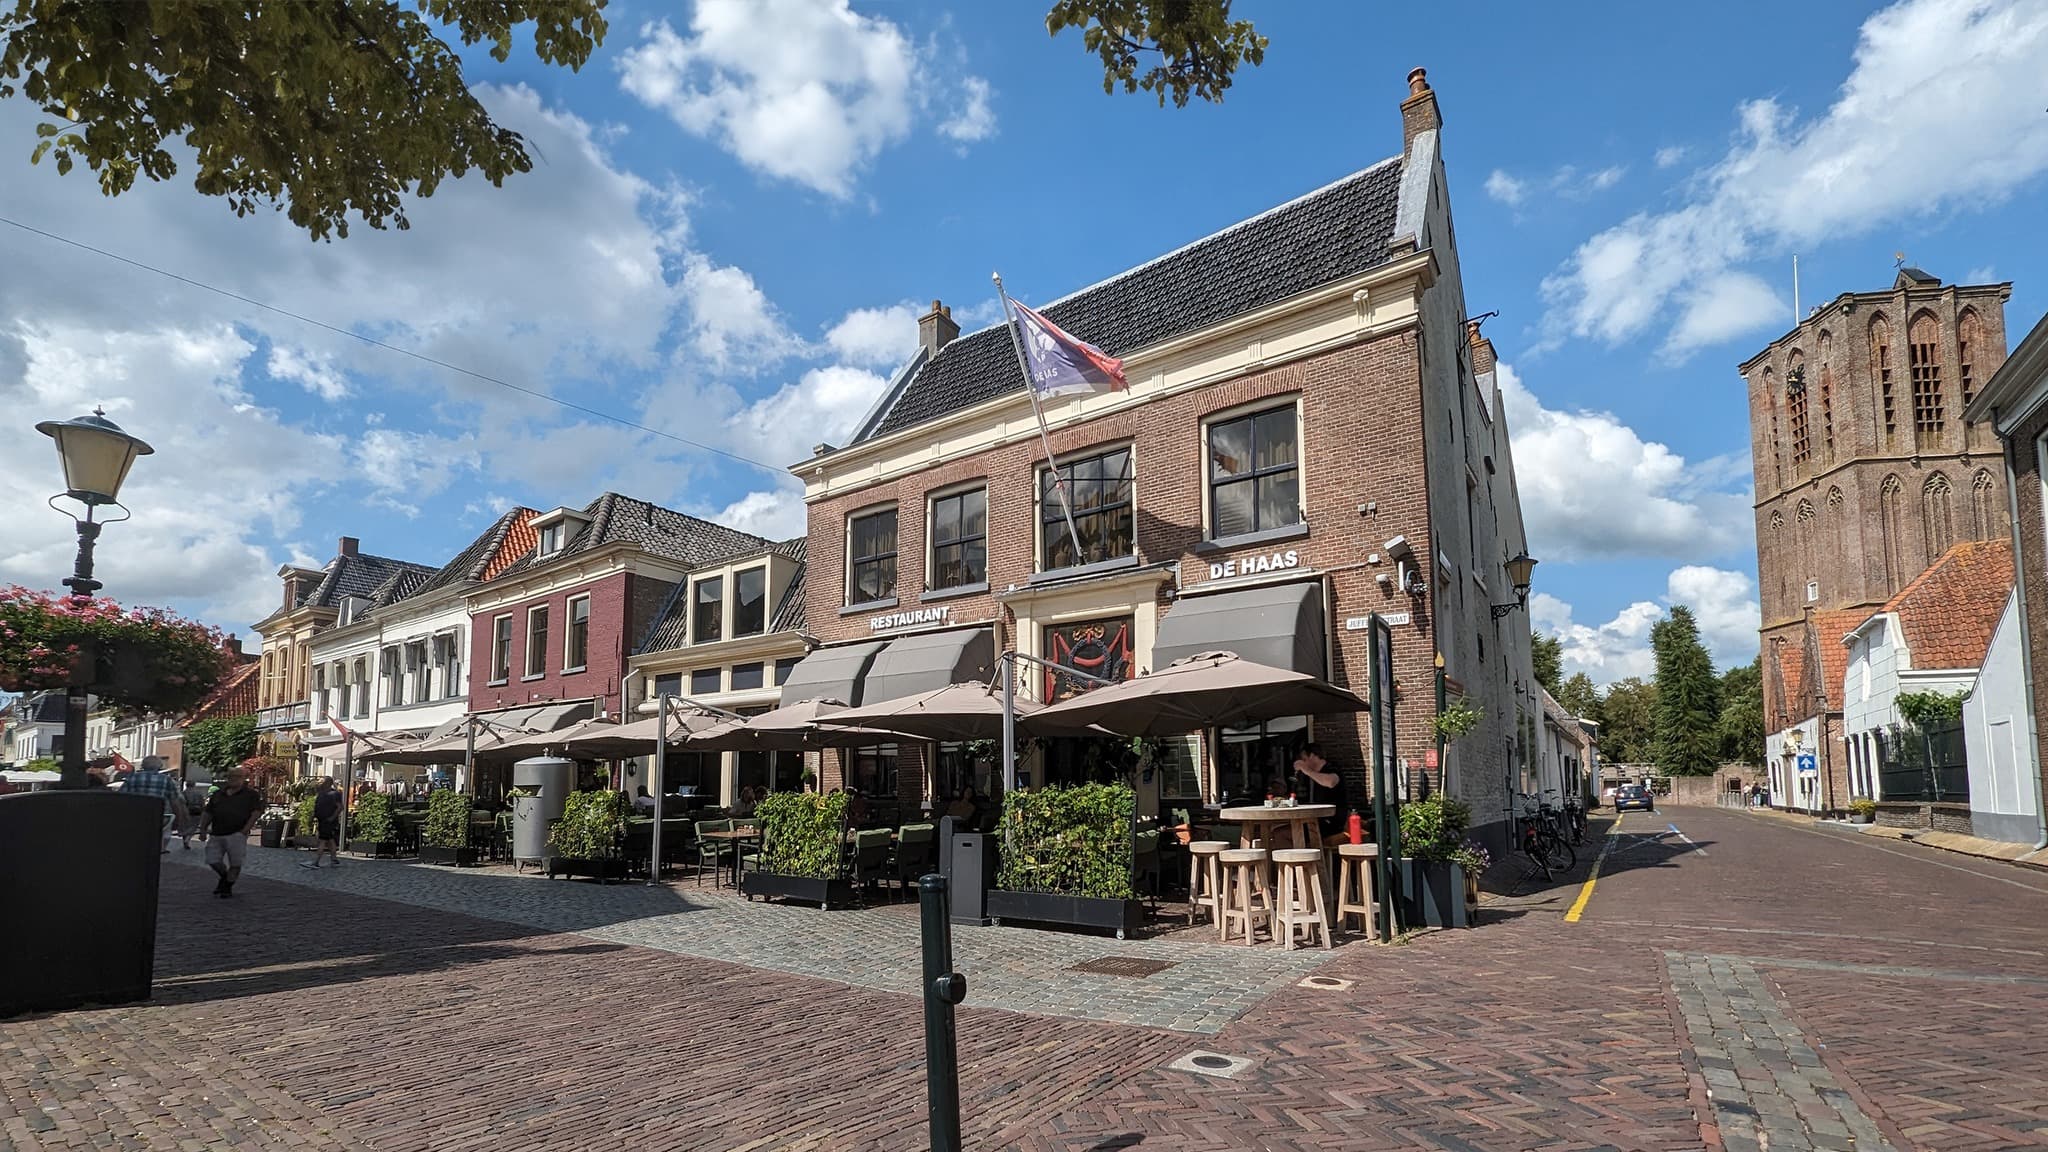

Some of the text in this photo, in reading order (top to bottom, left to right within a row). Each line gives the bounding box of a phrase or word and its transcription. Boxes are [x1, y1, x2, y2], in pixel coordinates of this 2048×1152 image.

[1210, 550, 1298, 579] DE HAAS
[870, 606, 950, 630] RESTAURANT
